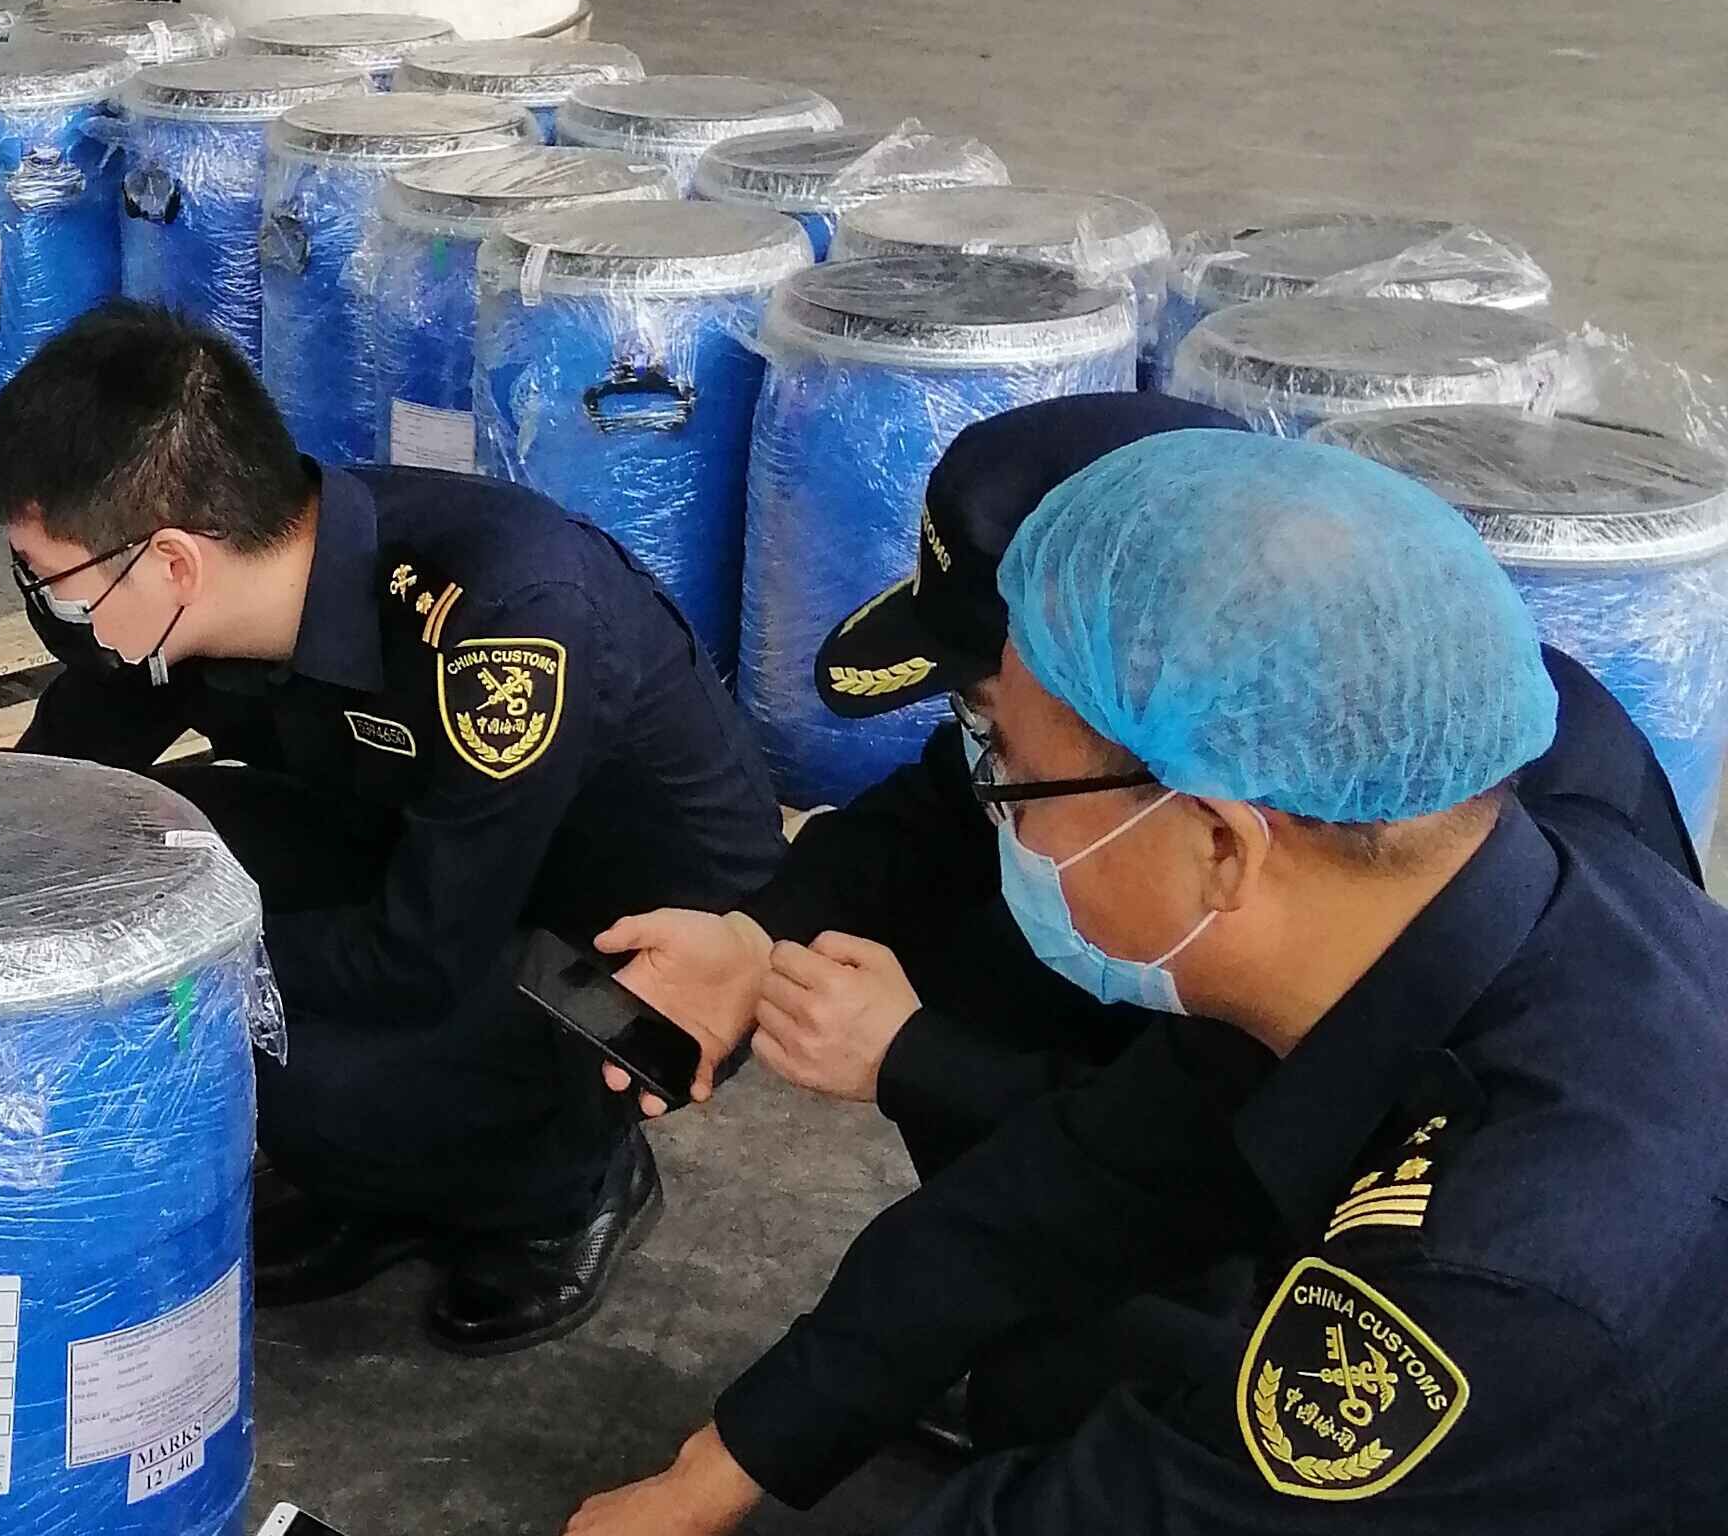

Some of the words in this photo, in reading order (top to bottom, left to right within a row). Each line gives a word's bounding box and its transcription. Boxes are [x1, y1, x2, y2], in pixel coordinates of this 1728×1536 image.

[447, 651, 489, 675] CHINA
[491, 650, 558, 675] CUSTOMS
[1294, 1285, 1355, 1319] CHINA
[1358, 1311, 1448, 1411] CUSTOMS
[136, 1420, 203, 1467] MARKS
[145, 1469, 163, 1491] 12
[177, 1454, 194, 1473] 40
